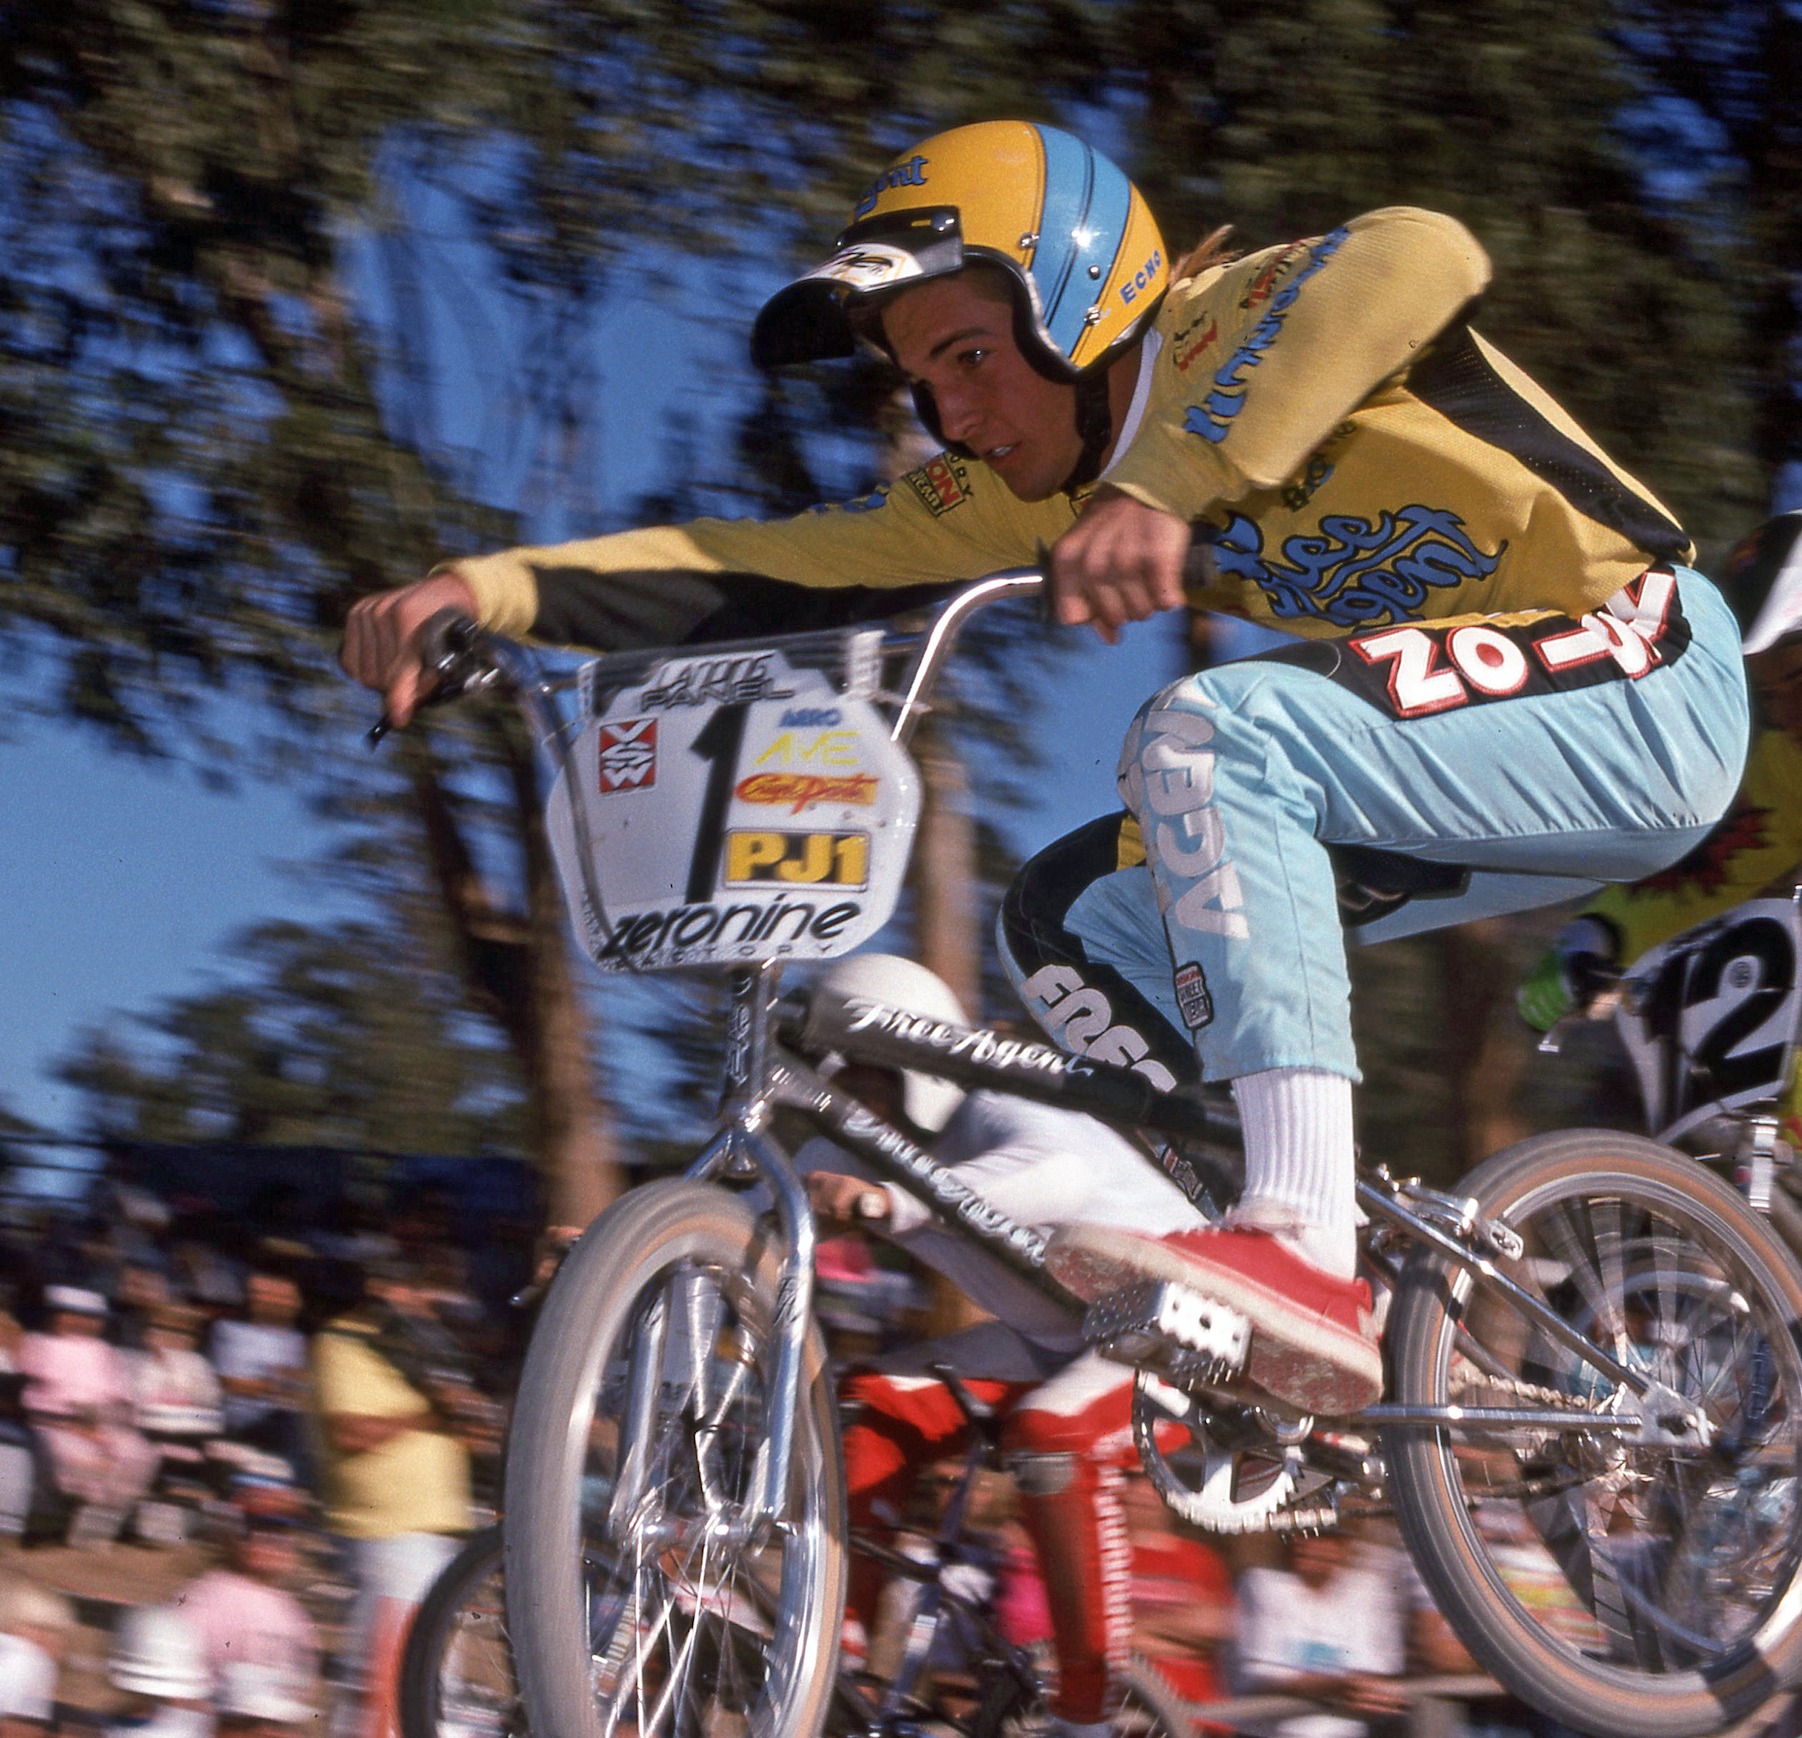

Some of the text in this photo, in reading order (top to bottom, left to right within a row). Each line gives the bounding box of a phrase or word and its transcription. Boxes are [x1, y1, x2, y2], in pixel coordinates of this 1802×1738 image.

[686, 701, 751, 905] 1
[729, 832, 866, 885] PJ1
[842, 997, 1095, 1077] Free Agent
